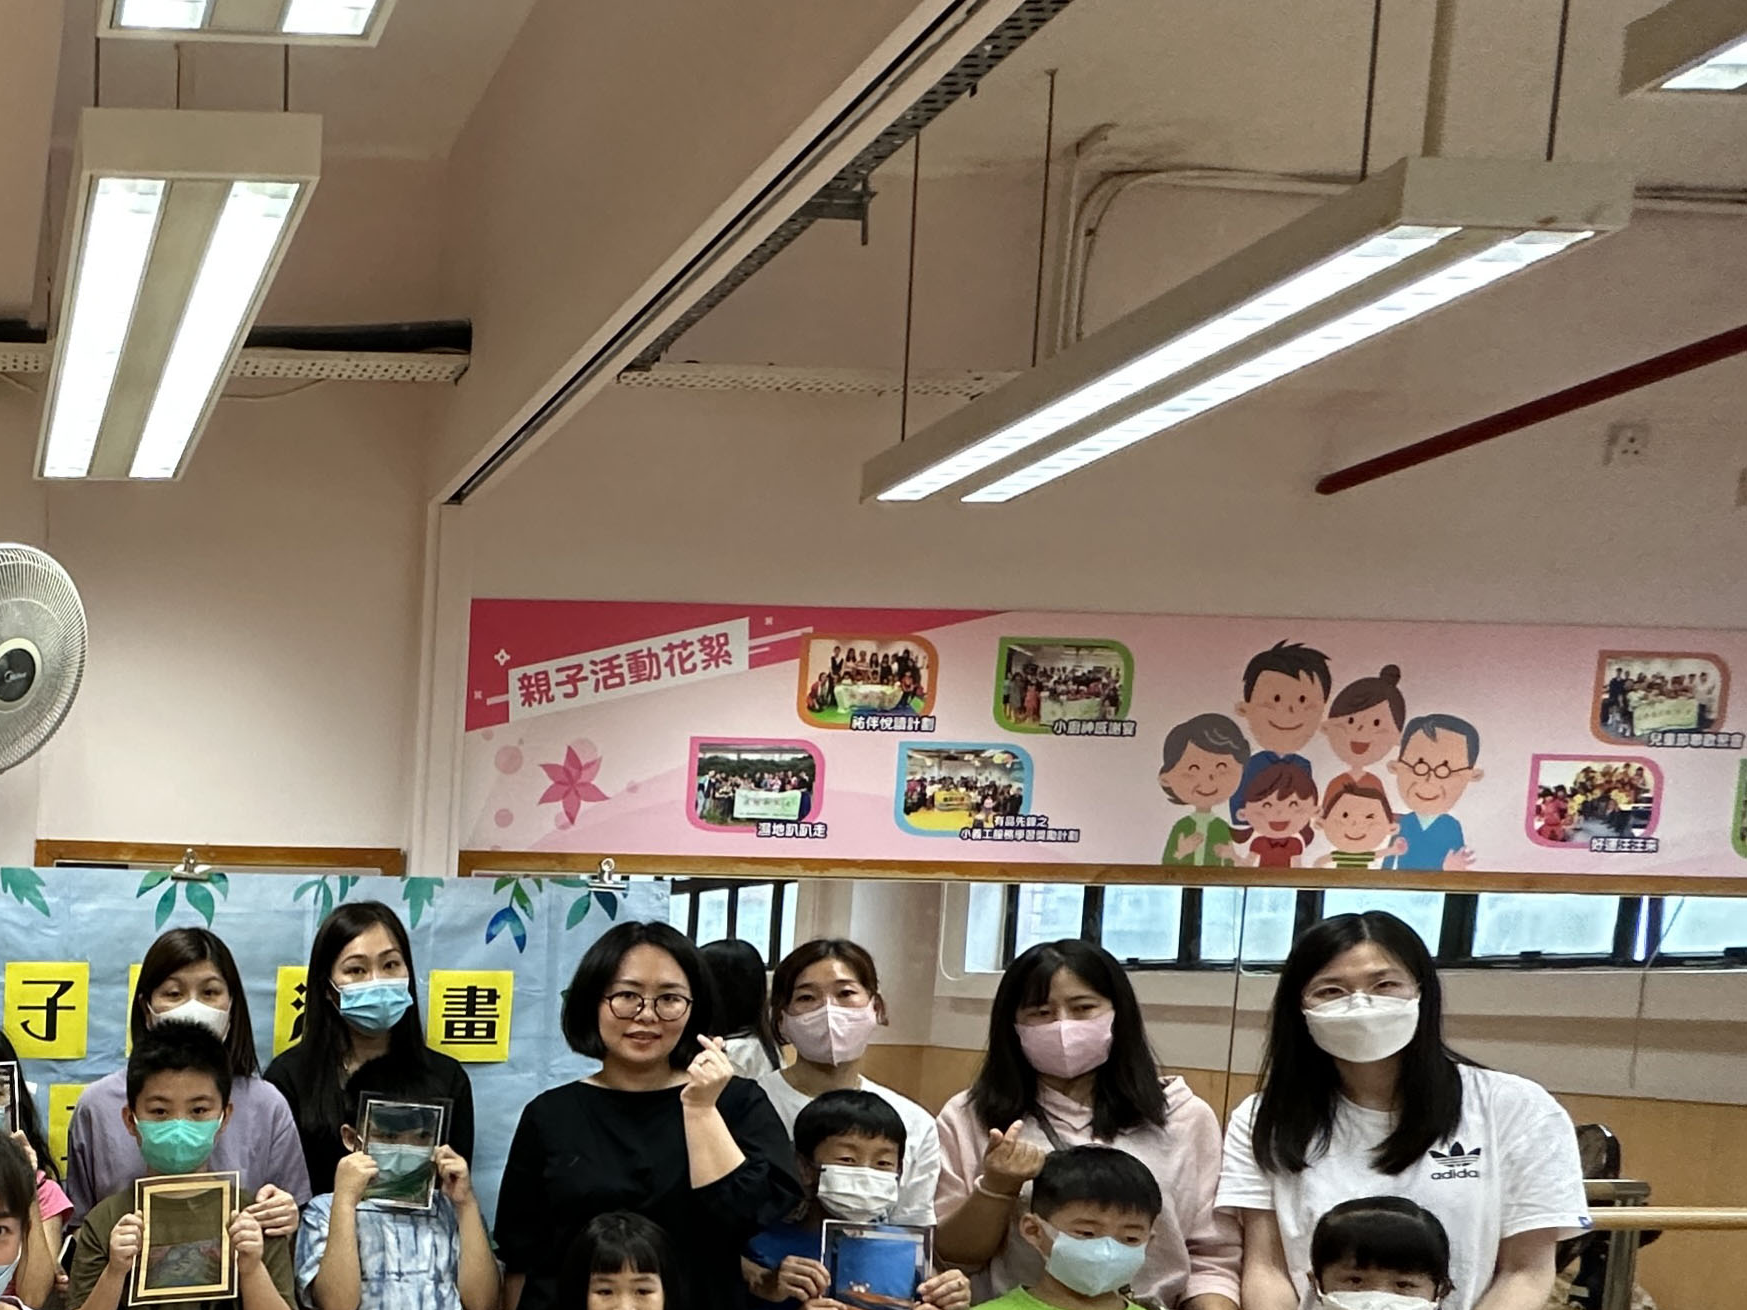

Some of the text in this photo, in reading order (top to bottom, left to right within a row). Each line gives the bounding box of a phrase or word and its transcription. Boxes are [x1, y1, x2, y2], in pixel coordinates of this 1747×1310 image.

[517, 632, 734, 708] 親子活動花絮
[17, 979, 501, 1045] 子 畫
[1431, 1168, 1480, 1180] adida
